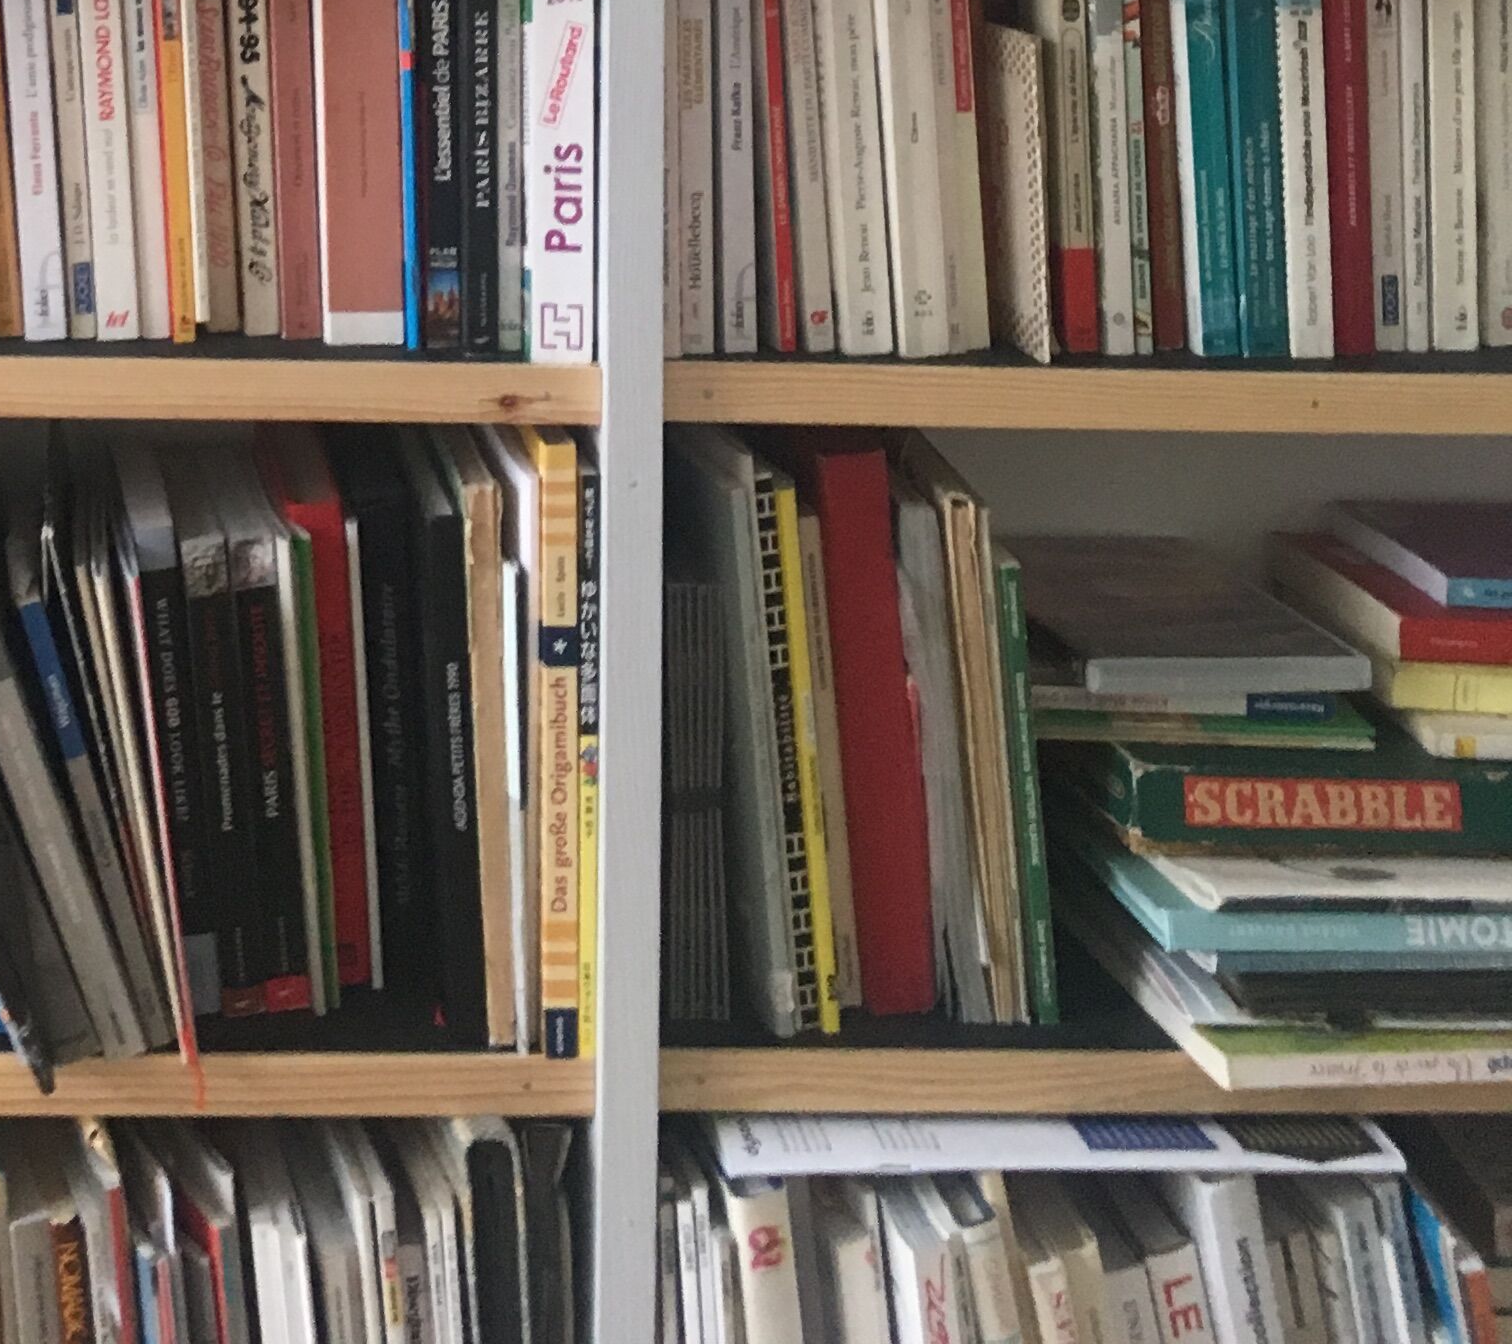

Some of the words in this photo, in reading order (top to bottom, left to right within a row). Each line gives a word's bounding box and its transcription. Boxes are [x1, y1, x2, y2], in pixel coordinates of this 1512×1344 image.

[844, 14, 860, 43] père
[433, 59, 450, 83] de
[471, 9, 491, 127] BIZARRE
[549, 24, 585, 104] Routard
[682, 18, 692, 85] PARTICULES
[846, 43, 858, 73] mon
[94, 26, 116, 122] RAYMOND
[1295, 47, 1309, 107] Macintosh
[543, 103, 562, 125] Le
[729, 81, 742, 117] Kafka
[804, 95, 815, 112] DU
[28, 111, 42, 159] Ferrante
[432, 83, 454, 182] L'essentiel
[731, 119, 743, 150] Franz
[1300, 110, 1313, 137] pour
[472, 129, 492, 208] PARIS
[504, 141, 520, 193] Queneau
[806, 115, 819, 182] MANIFESTE
[30, 159, 44, 197] Elena
[542, 142, 584, 252] Paris
[1244, 187, 1257, 213] d'un
[504, 195, 520, 247] Raymond
[1411, 194, 1422, 239] Mauriac
[1453, 232, 1465, 245] de
[687, 191, 705, 291] Houellebecq
[856, 223, 870, 263] Renoir
[1245, 216, 1261, 262] mariage
[1263, 238, 1276, 262] Une
[1302, 234, 1315, 258] Loo
[859, 266, 875, 294] Jean
[1303, 260, 1316, 285] Van
[1453, 248, 1465, 287] Simone
[1304, 289, 1318, 326] Robert
[155, 597, 170, 646] WHAT
[159, 651, 176, 694] DOES
[209, 691, 225, 705] le
[211, 705, 229, 742] dans
[546, 676, 572, 805] Origamibuch
[170, 732, 185, 775] LOOK
[214, 742, 235, 833] Promenades
[261, 769, 282, 819] PARIS
[452, 775, 468, 832] AGENDA
[1188, 778, 1456, 832] SCRABBLE
[548, 810, 572, 868] große
[548, 875, 568, 913] Das
[1162, 1274, 1204, 1339] LE
